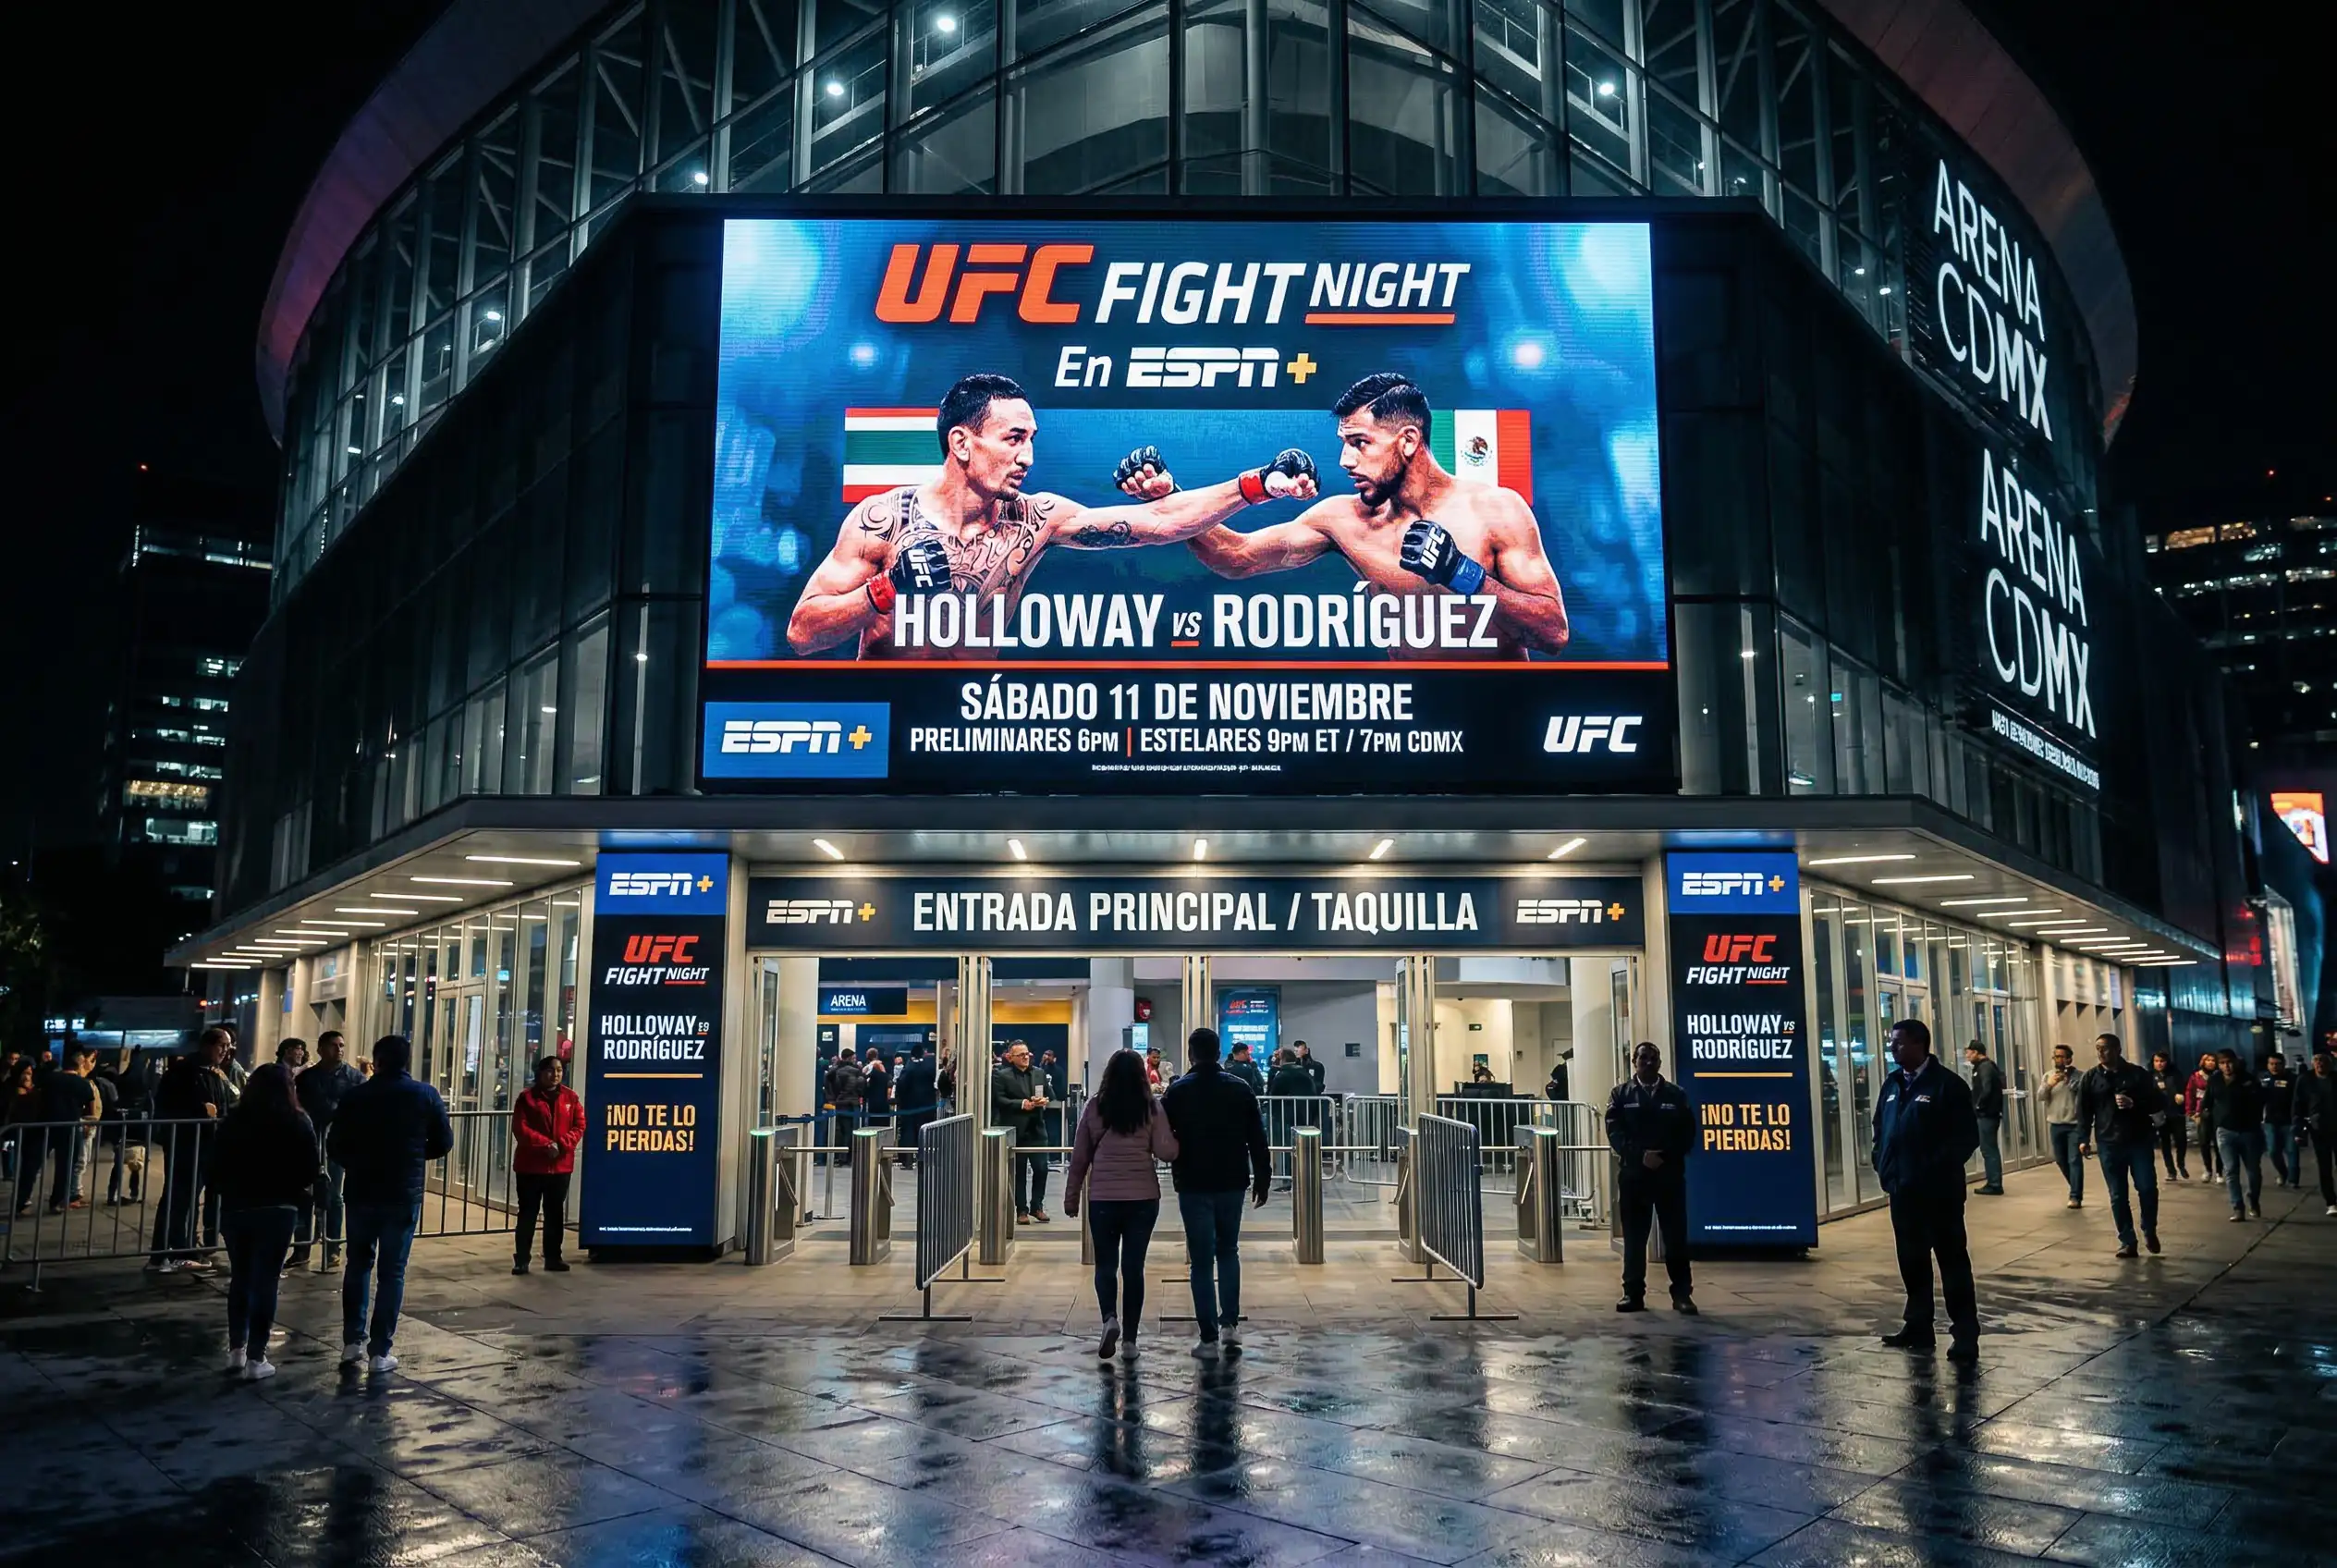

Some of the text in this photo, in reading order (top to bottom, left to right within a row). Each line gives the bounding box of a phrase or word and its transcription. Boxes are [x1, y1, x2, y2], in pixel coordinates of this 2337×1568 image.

[1934, 159, 2045, 342] ARENA
[875, 244, 1471, 325] UFC FIGHT NIGHT
[1938, 262, 2053, 442] CDMX
[1054, 346, 1317, 387] En ESPN+
[1420, 526, 1446, 570] UFC
[1981, 447, 2087, 627] ARENA
[907, 549, 934, 588] UFC
[894, 581, 1499, 649] HOLLOWAY VS RODRÍGUEZ
[1986, 568, 2097, 739] CDMX
[960, 673, 1413, 721] SÁBADO 11 DE NOVIEMBRE
[721, 720, 873, 753] ESPN+
[910, 727, 1464, 753] PRELIMINARES 6PM ESTELARES 9PM ET / 7PM CDMX
[1543, 716, 1643, 753] UFC
[608, 872, 715, 896] ESPN+
[1682, 872, 1786, 896] ESPN+
[765, 900, 876, 925] ESPN+
[913, 892, 1478, 936] ENTRADA PRINCIPAL / TAQUILLA
[1516, 899, 1625, 924] ESPN+
[623, 935, 700, 963] UFC
[1703, 934, 1777, 962] UFC
[604, 967, 710, 986] FIGHT NIGHT
[1685, 966, 1790, 985] FIGHT NIGHT
[830, 994, 866, 1007] ARENA
[601, 1014, 697, 1035] HOLLOWAY
[1686, 1013, 1782, 1035] HOLLOWAY
[603, 1035, 705, 1060] RODRÍGUEZ
[1692, 1034, 1793, 1060] RODRÍGUEZ
[606, 1104, 696, 1127] ¡NO TE LO
[1701, 1103, 1791, 1126] ¡NO TE LO
[606, 1129, 695, 1152] PIERDAS!
[1704, 1129, 1791, 1151] PIERDAS!
